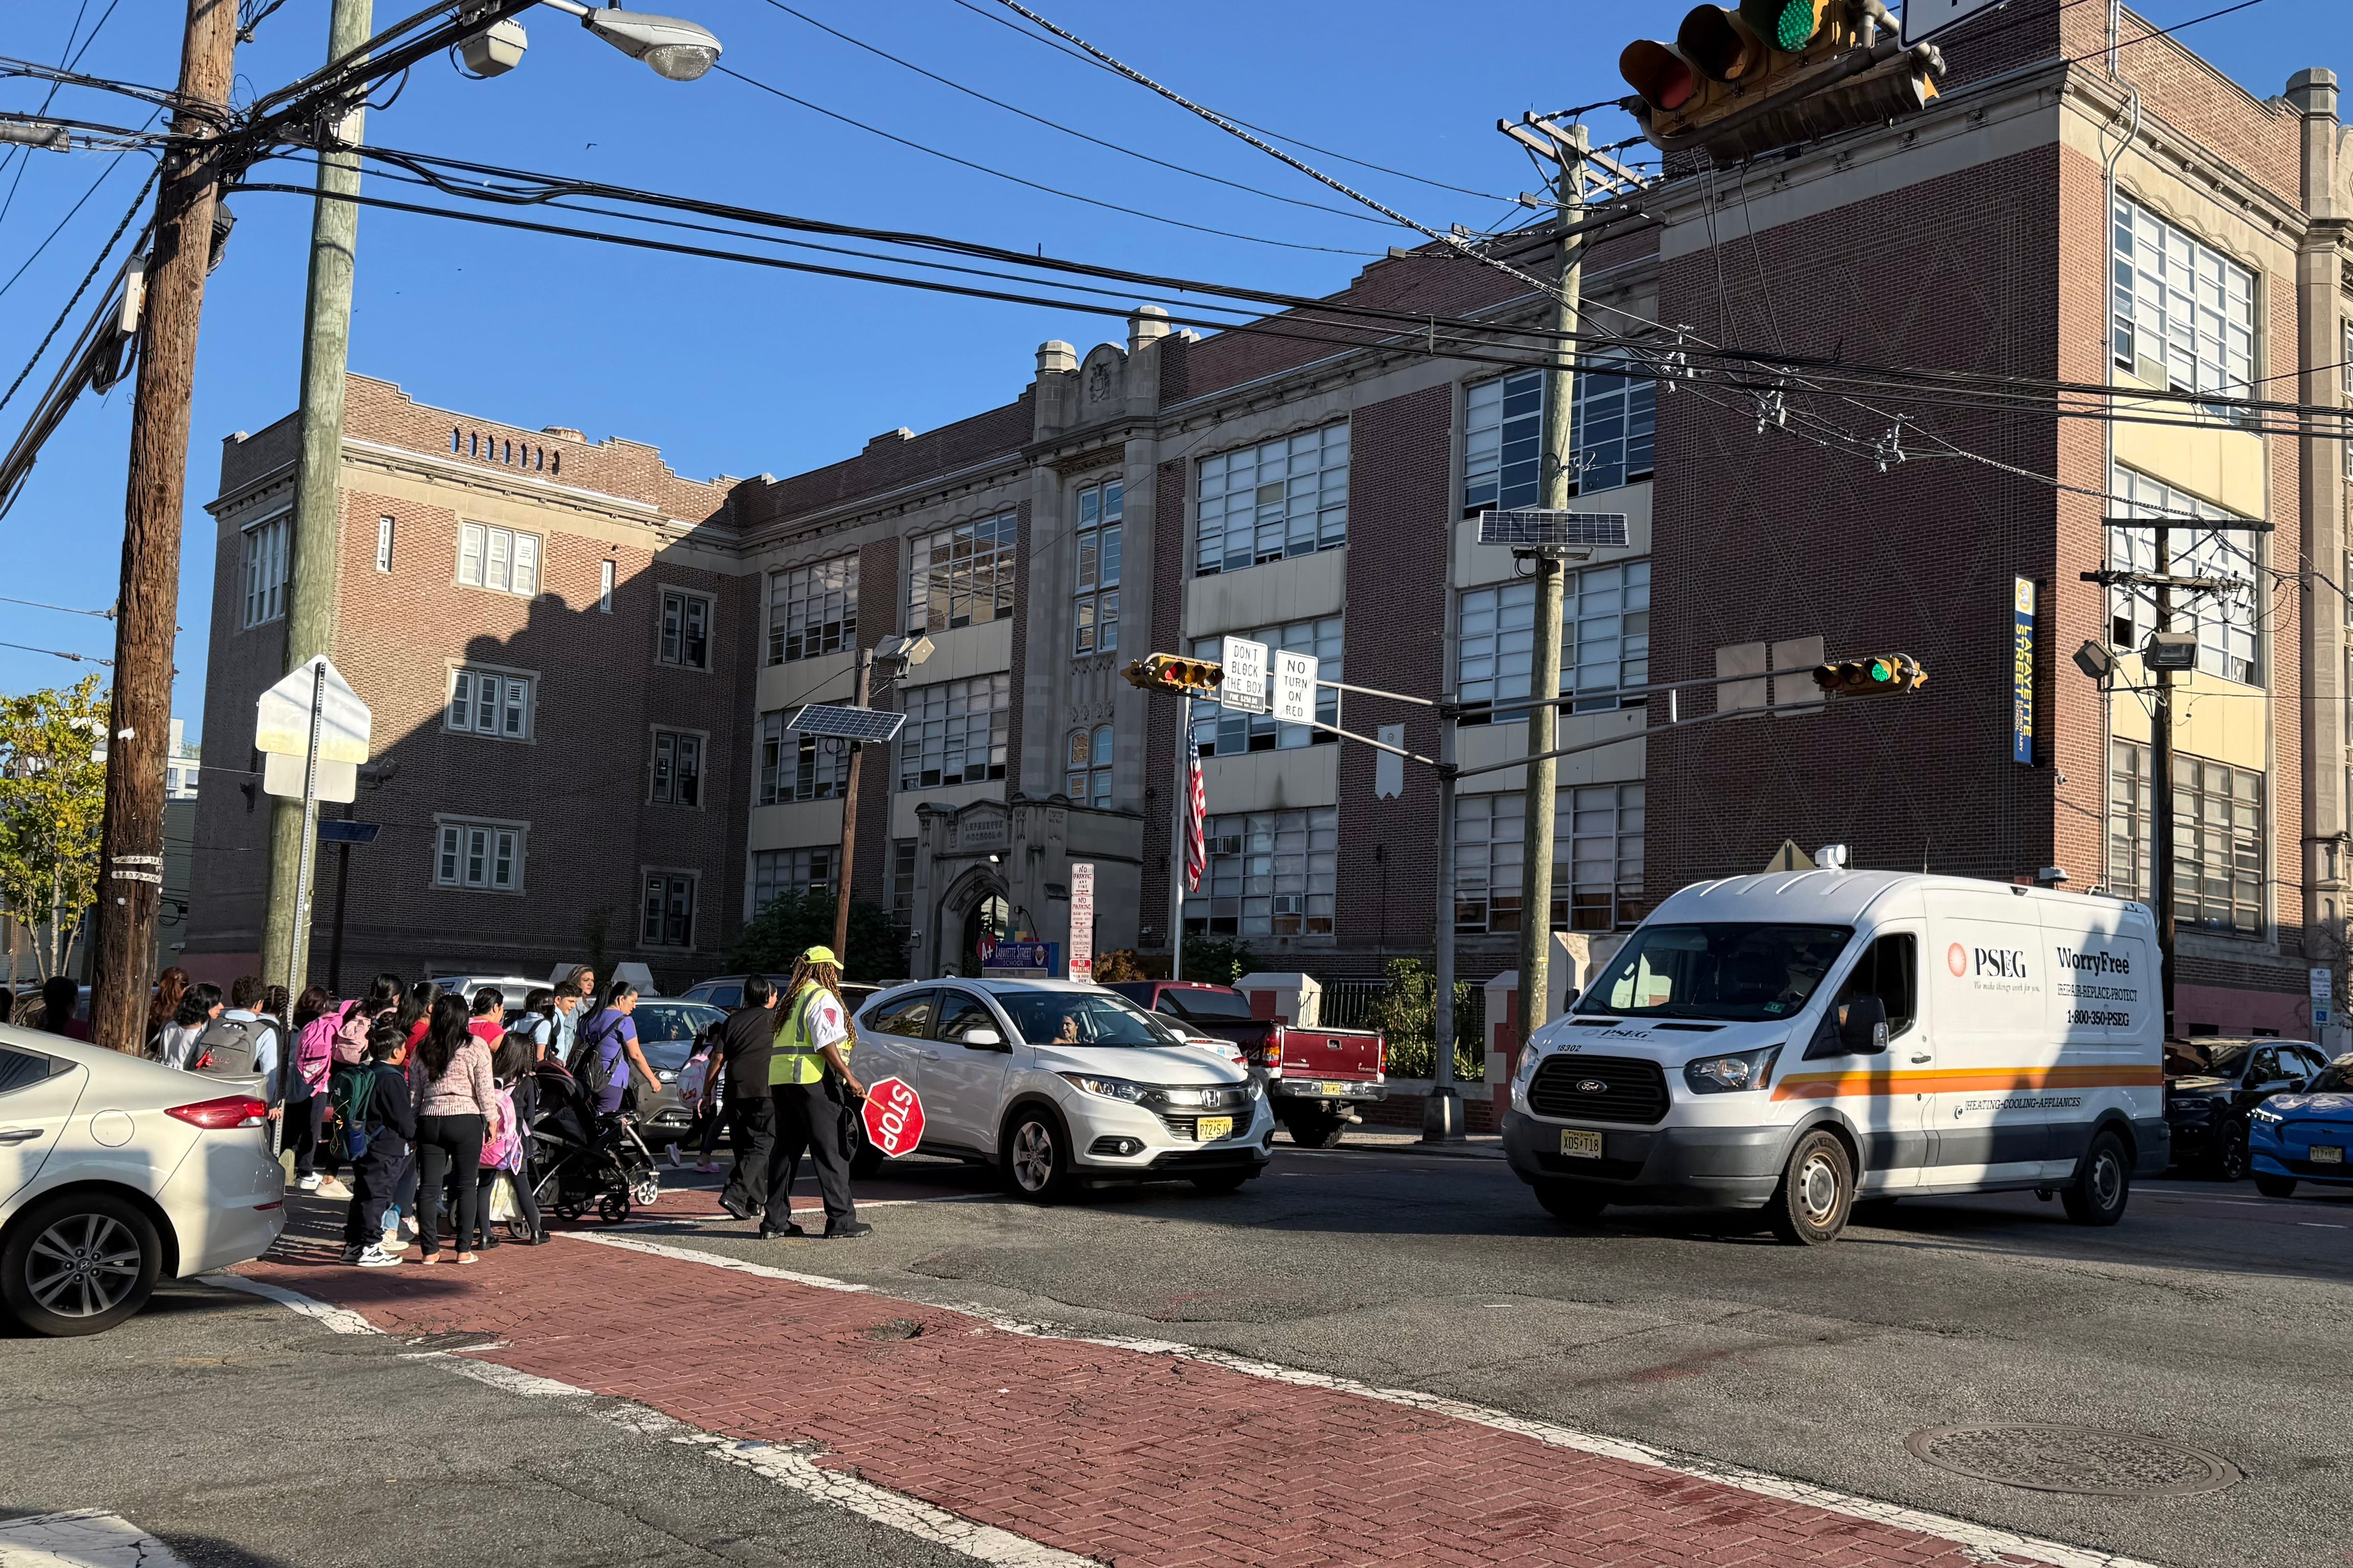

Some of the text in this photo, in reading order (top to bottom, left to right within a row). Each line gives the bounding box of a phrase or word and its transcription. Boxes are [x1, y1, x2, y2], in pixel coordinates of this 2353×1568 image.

[1234, 645, 1257, 661] DONT
[2015, 623, 2024, 698] STREET
[1232, 661, 1257, 678] BLOCK
[1288, 659, 1305, 674] NO
[1227, 677, 1262, 695] THE BOX
[1284, 676, 1307, 689] TURN
[2024, 625, 2032, 737] LAFAYETTE
[1289, 691, 1301, 702] ON
[1286, 705, 1303, 717] RED
[982, 943, 993, 961] A+
[1017, 945, 1032, 958] STREET
[2057, 947, 2129, 977] WorryFree
[1581, 1082, 1599, 1091] Ford
[878, 1084, 913, 1151] STOP
